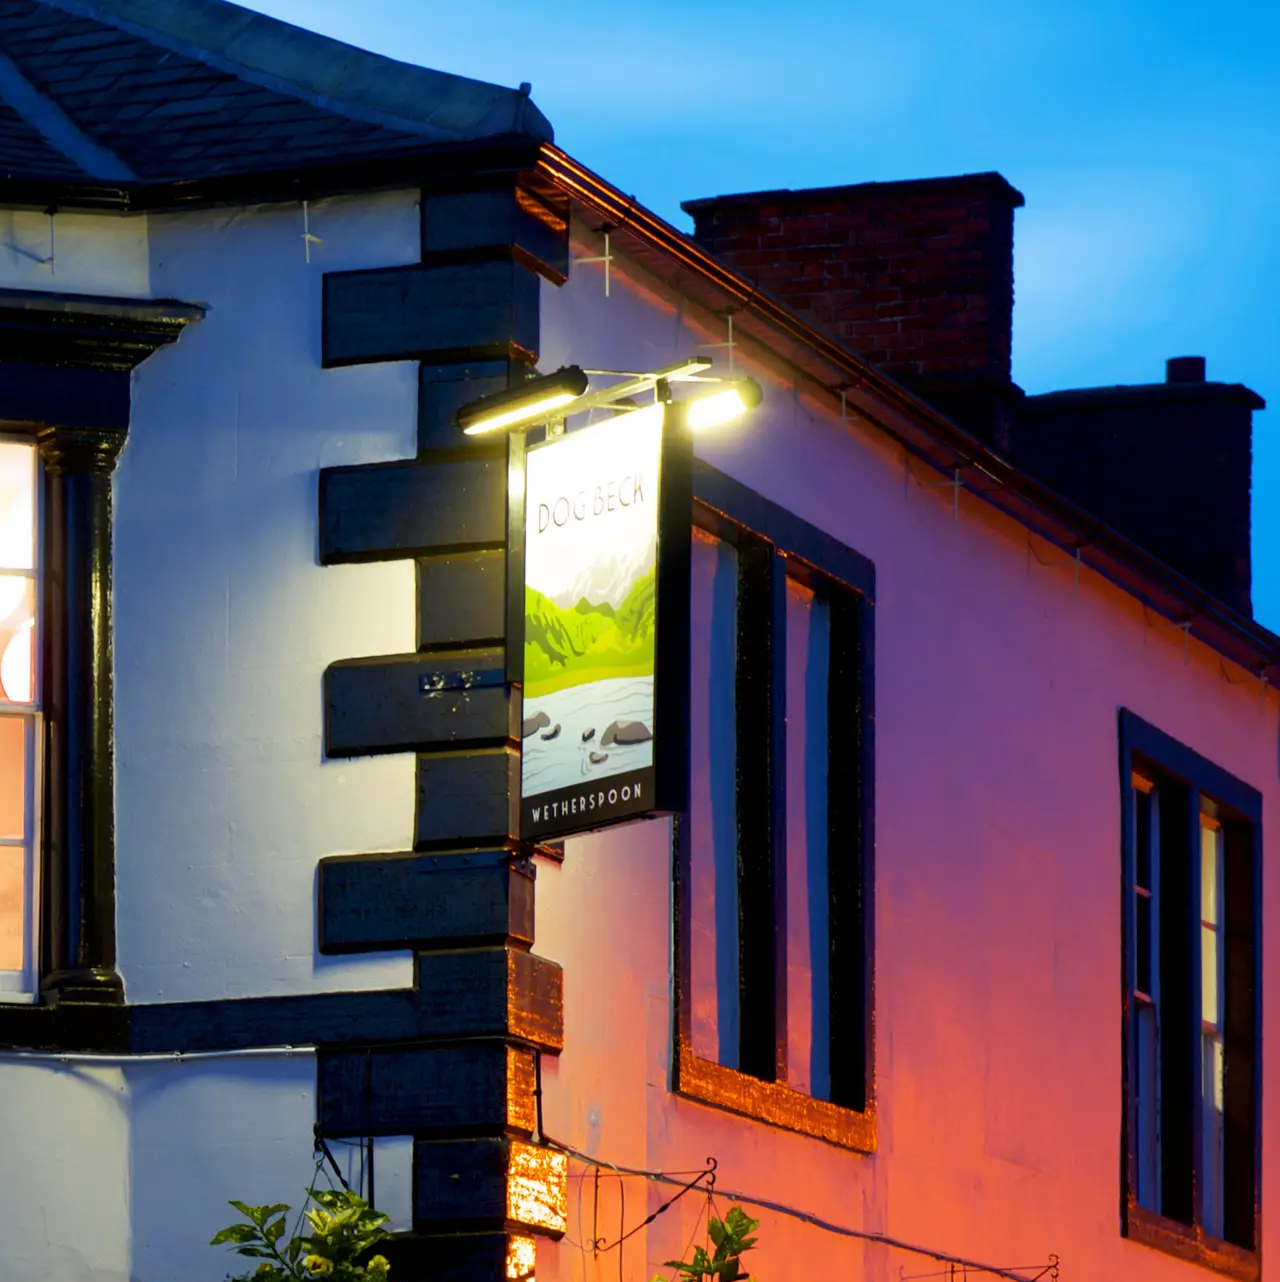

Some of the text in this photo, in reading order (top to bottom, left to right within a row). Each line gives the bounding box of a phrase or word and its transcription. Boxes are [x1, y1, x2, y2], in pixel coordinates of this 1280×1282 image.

[538, 472, 644, 534] DOG BECK
[531, 782, 642, 824] WETHERSPOON
